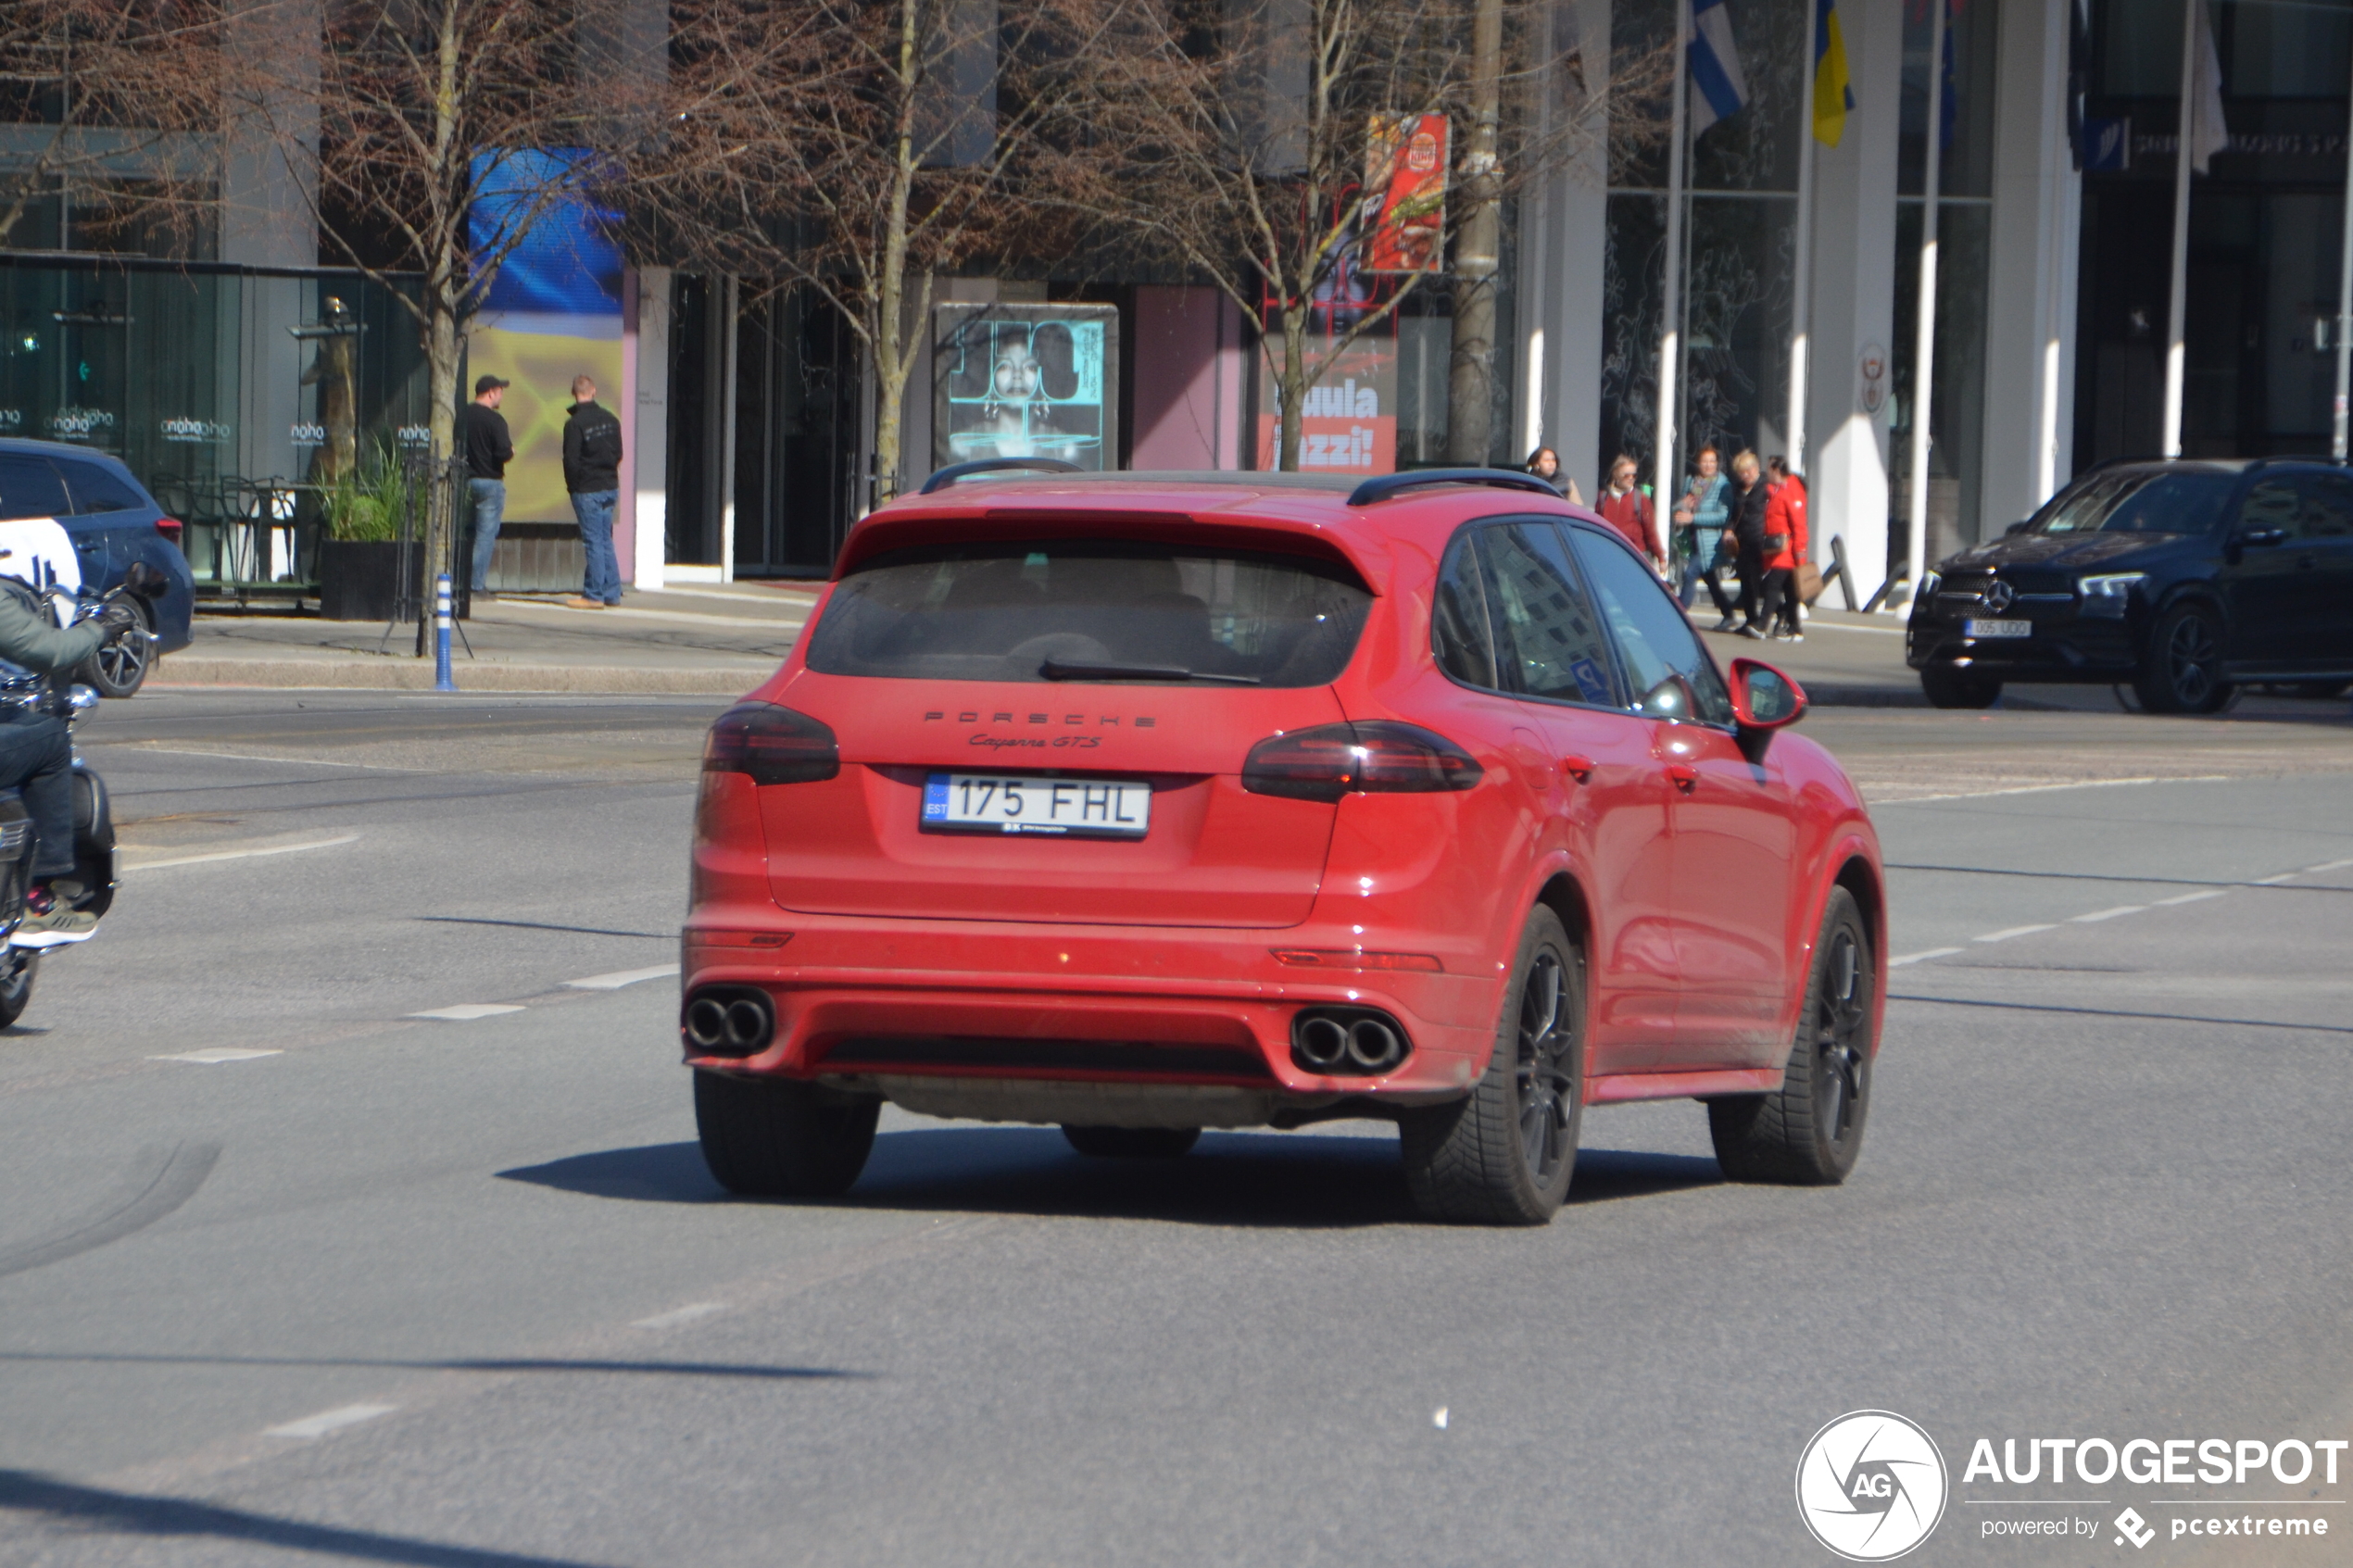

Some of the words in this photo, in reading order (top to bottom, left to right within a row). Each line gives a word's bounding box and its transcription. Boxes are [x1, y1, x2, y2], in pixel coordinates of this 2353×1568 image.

[1276, 379, 1378, 418] uula
[925, 711, 1156, 728] PORSCHE
[969, 734, 1046, 750] Cayenne
[1052, 735, 1103, 748] GTS
[927, 803, 948, 815] EST
[960, 779, 1025, 817] 175
[1051, 783, 1136, 823] FHL
